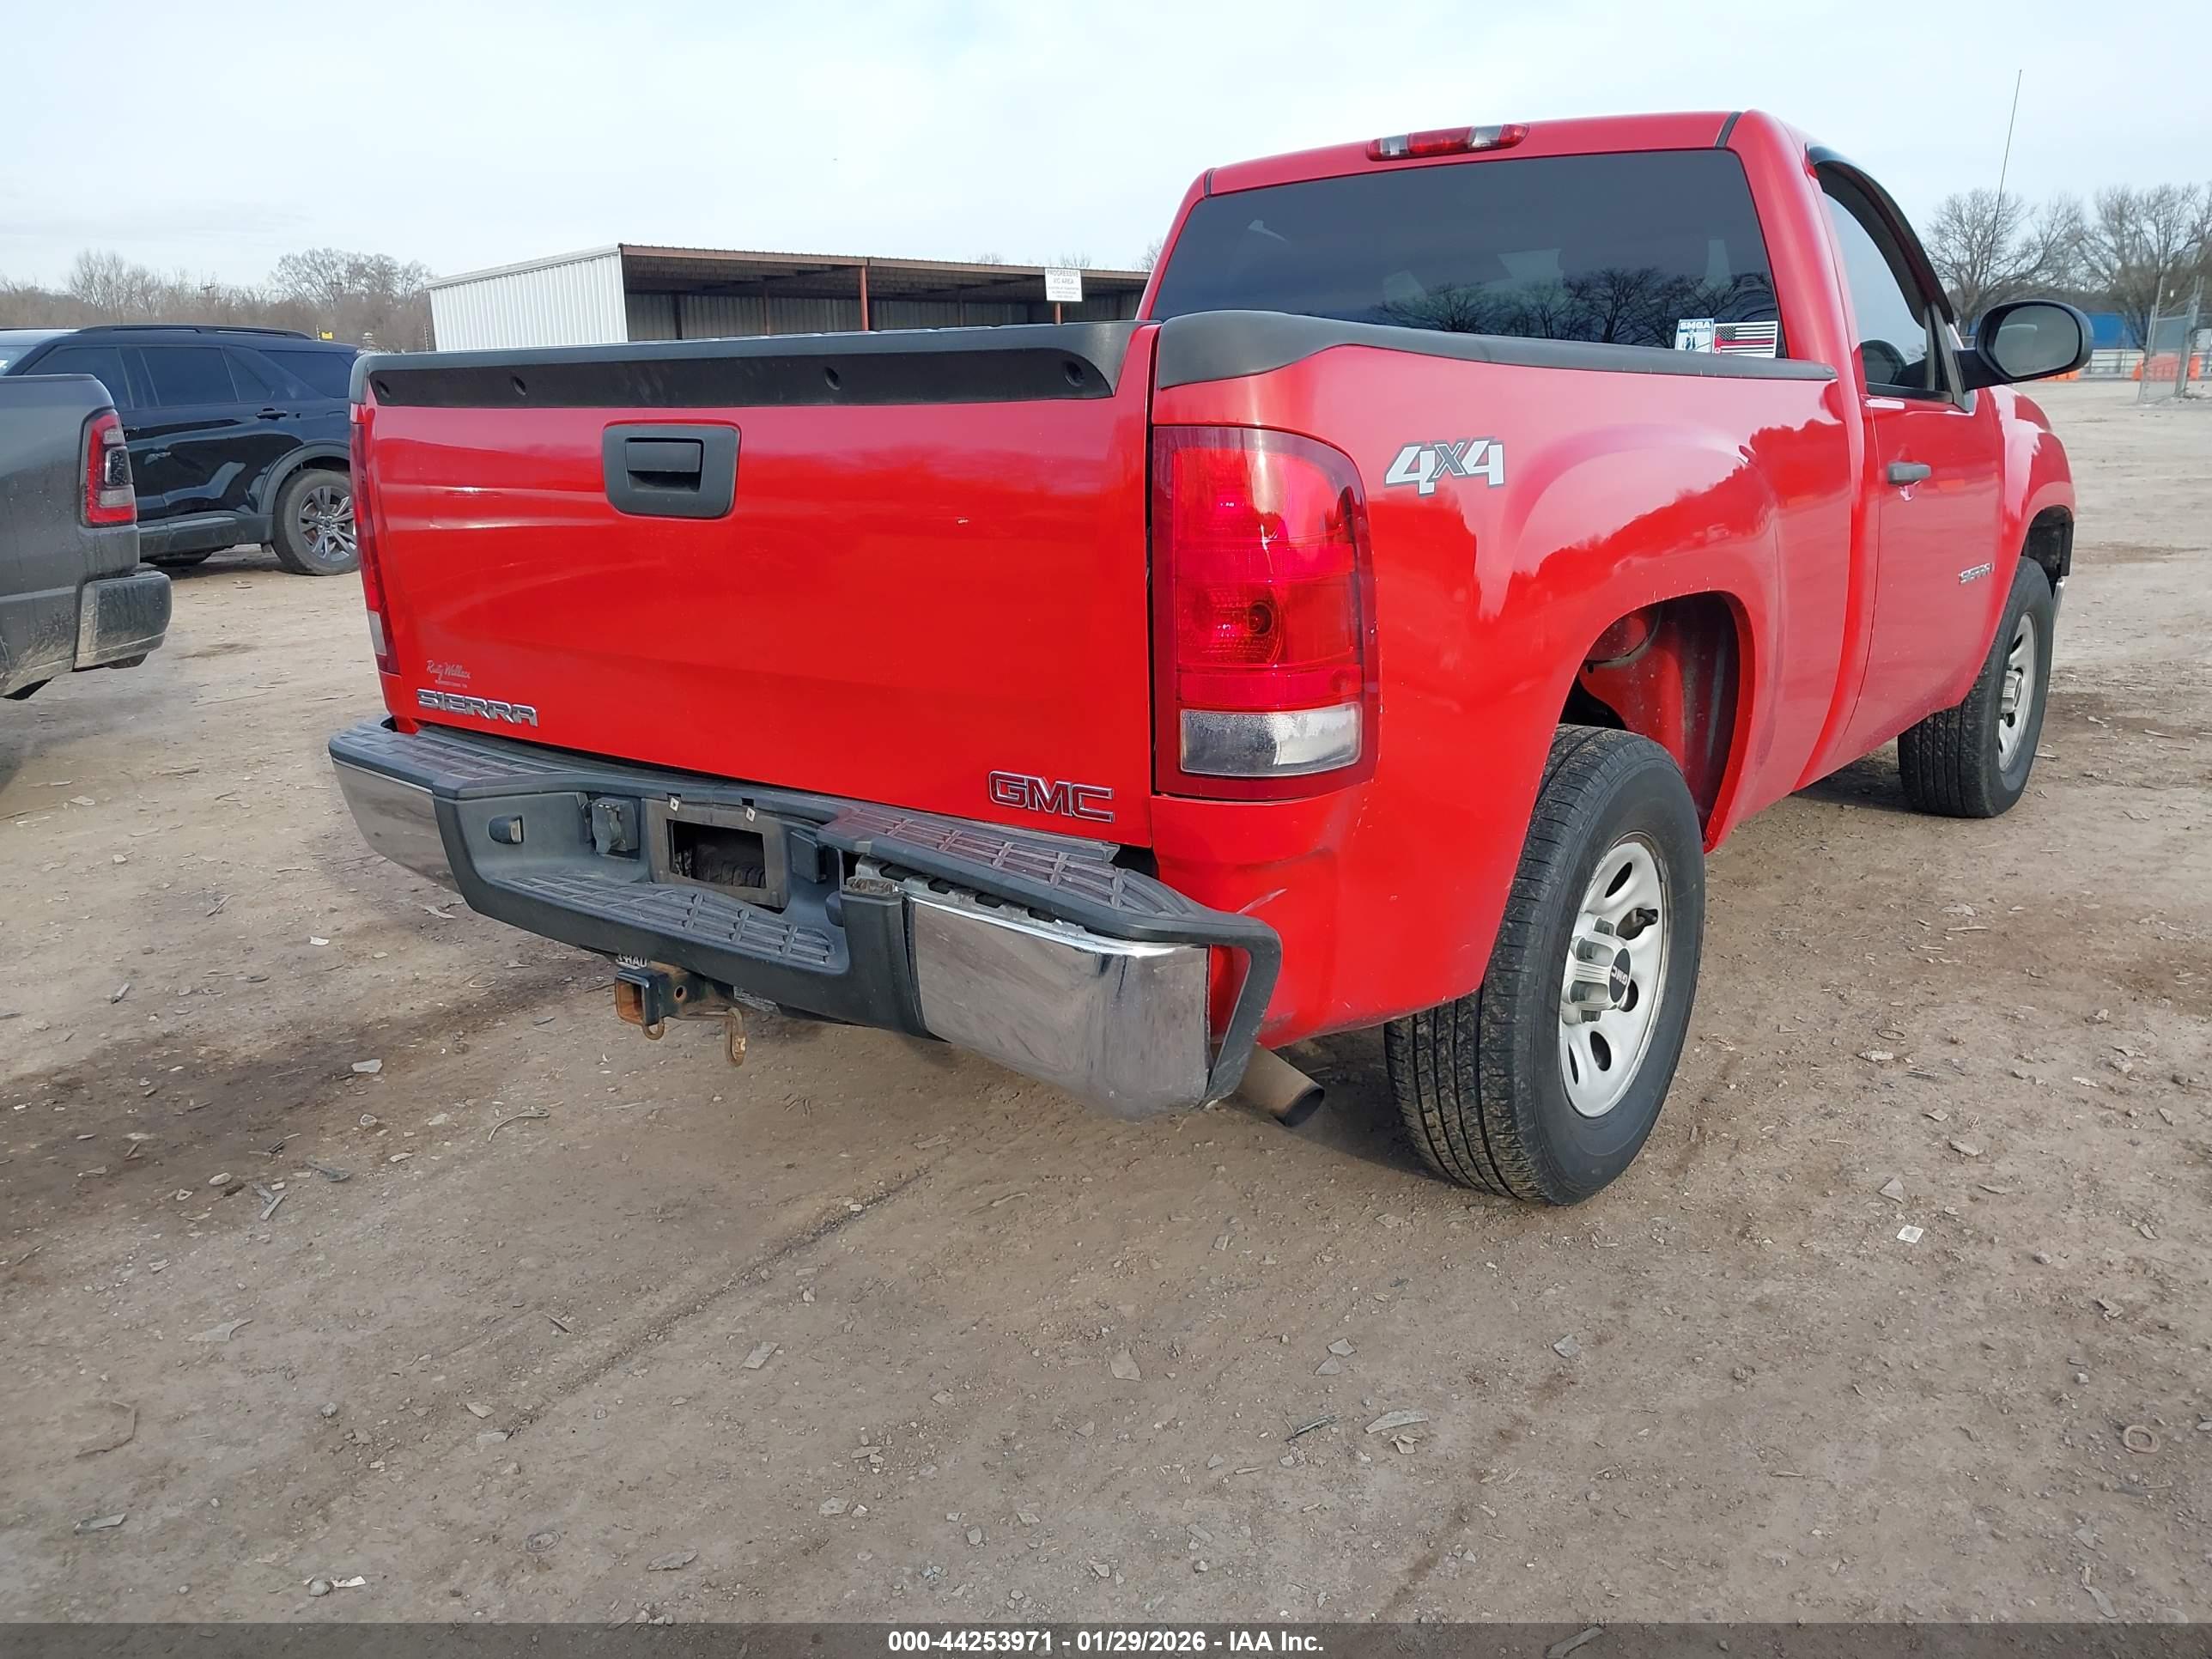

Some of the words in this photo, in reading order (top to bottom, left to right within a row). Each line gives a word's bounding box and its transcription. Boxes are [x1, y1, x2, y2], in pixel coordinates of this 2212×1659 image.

[416, 688, 538, 727] SIERRA
[989, 770, 1114, 823] GMC
[1611, 964, 1628, 986] GMC
